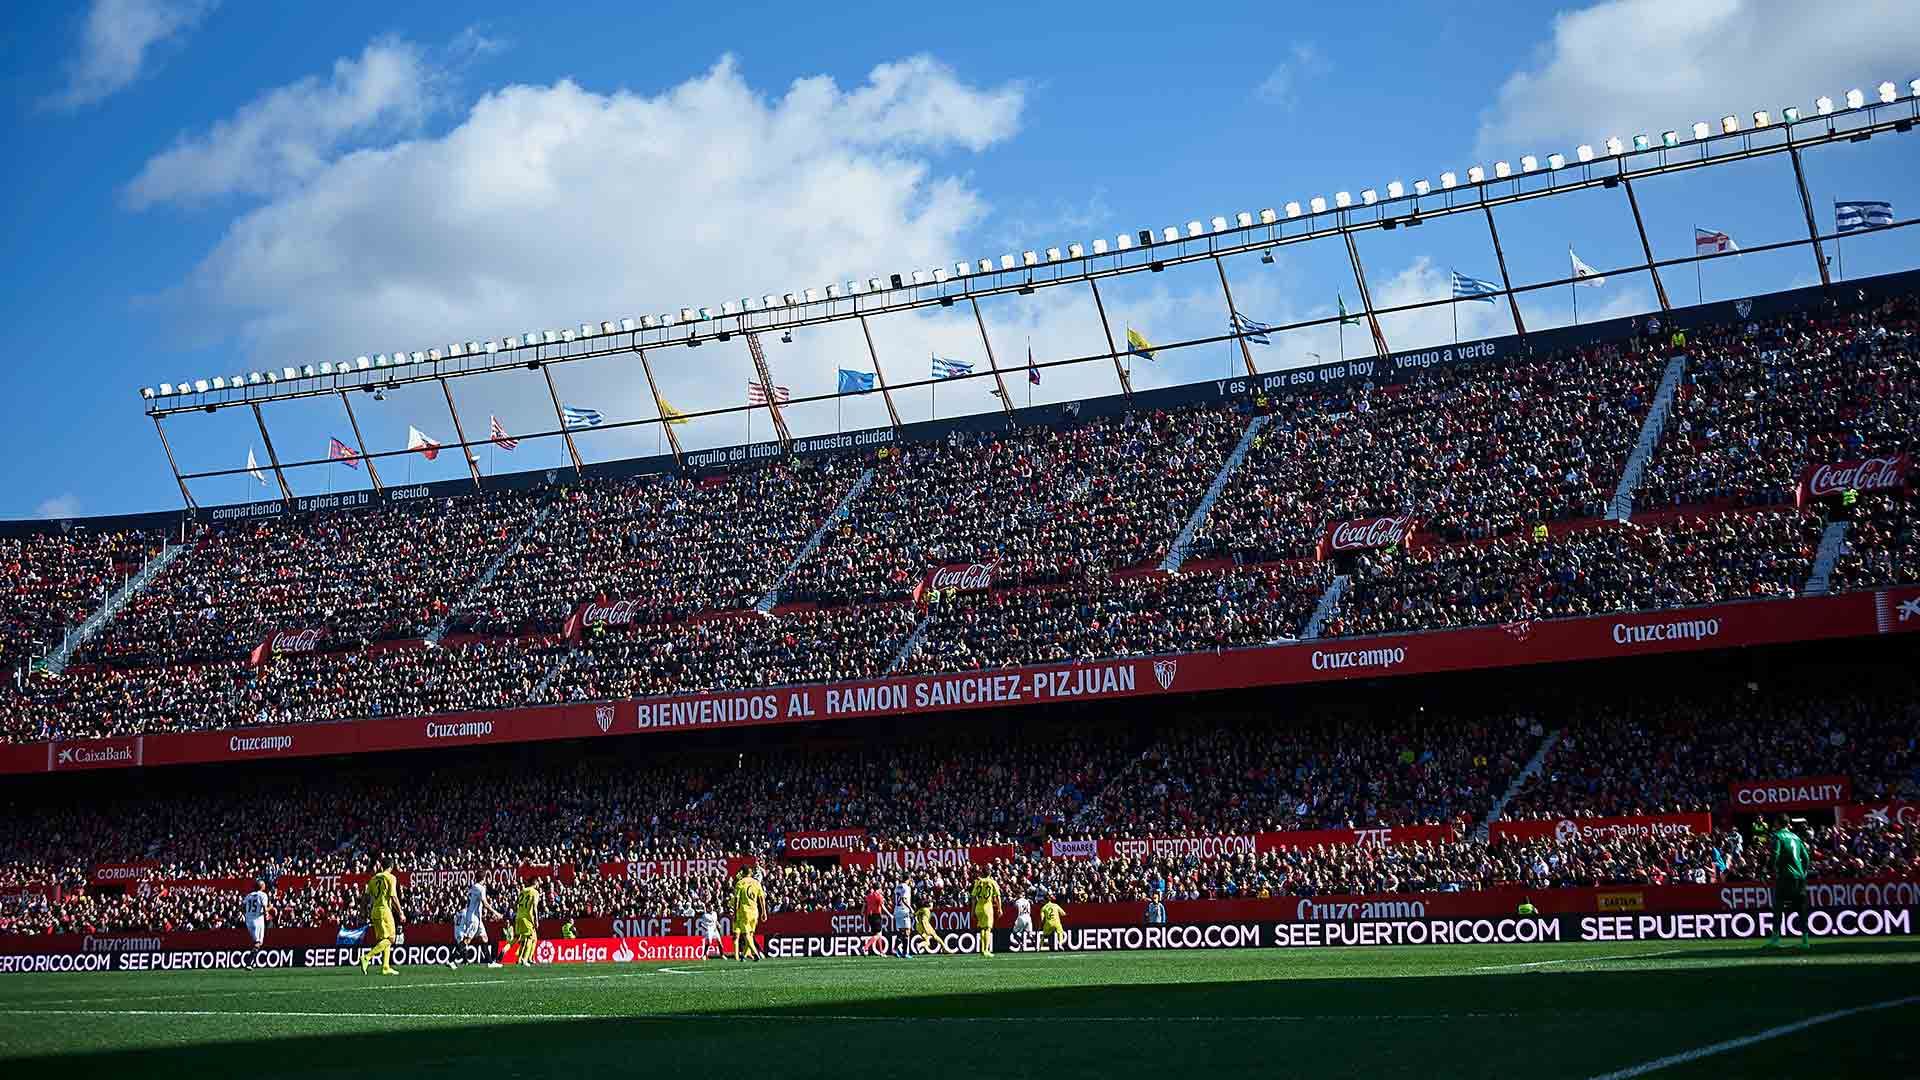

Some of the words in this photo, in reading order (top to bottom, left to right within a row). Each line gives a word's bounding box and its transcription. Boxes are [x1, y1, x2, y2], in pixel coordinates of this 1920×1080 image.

[1230, 381, 1246, 393] es
[1264, 374, 1287, 391] por
[1290, 371, 1315, 385] eso
[1320, 367, 1345, 383] que
[1349, 360, 1374, 379] hoy
[1395, 352, 1440, 371] vengo
[1443, 349, 1453, 361] a
[1457, 341, 1496, 359] verte
[688, 448, 727, 467] orgullo
[730, 447, 746, 461] del
[793, 439, 807, 453] de
[809, 435, 852, 450] nuestra
[855, 427, 894, 445] ciudad
[212, 501, 282, 520] compartiendo
[298, 499, 308, 511] la
[309, 495, 339, 512] gloria
[343, 497, 356, 507] en
[358, 492, 369, 504] tu
[391, 485, 430, 501] escudo
[1613, 618, 1721, 644] Cruzcampo
[1312, 647, 1406, 670] Cruzcampo
[638, 694, 777, 728] BIENVENIDOS
[788, 693, 816, 717] AL
[826, 684, 908, 714] RAMON
[915, 665, 1135, 707] SANCHEZ-PIZJUAN
[427, 720, 495, 738] Cruzcampo
[229, 735, 294, 751] Cruzcampo
[75, 746, 133, 763] CaixaBank
[1737, 785, 1843, 804] CORDIALITY
[791, 834, 861, 850] CORDIALITY
[1275, 923, 1321, 947] SEE
[1580, 916, 1634, 942] SEE
[304, 948, 337, 967] SEE
[558, 943, 607, 962] LaLiga
[768, 937, 806, 958] SEE
[119, 954, 149, 970] SEE
